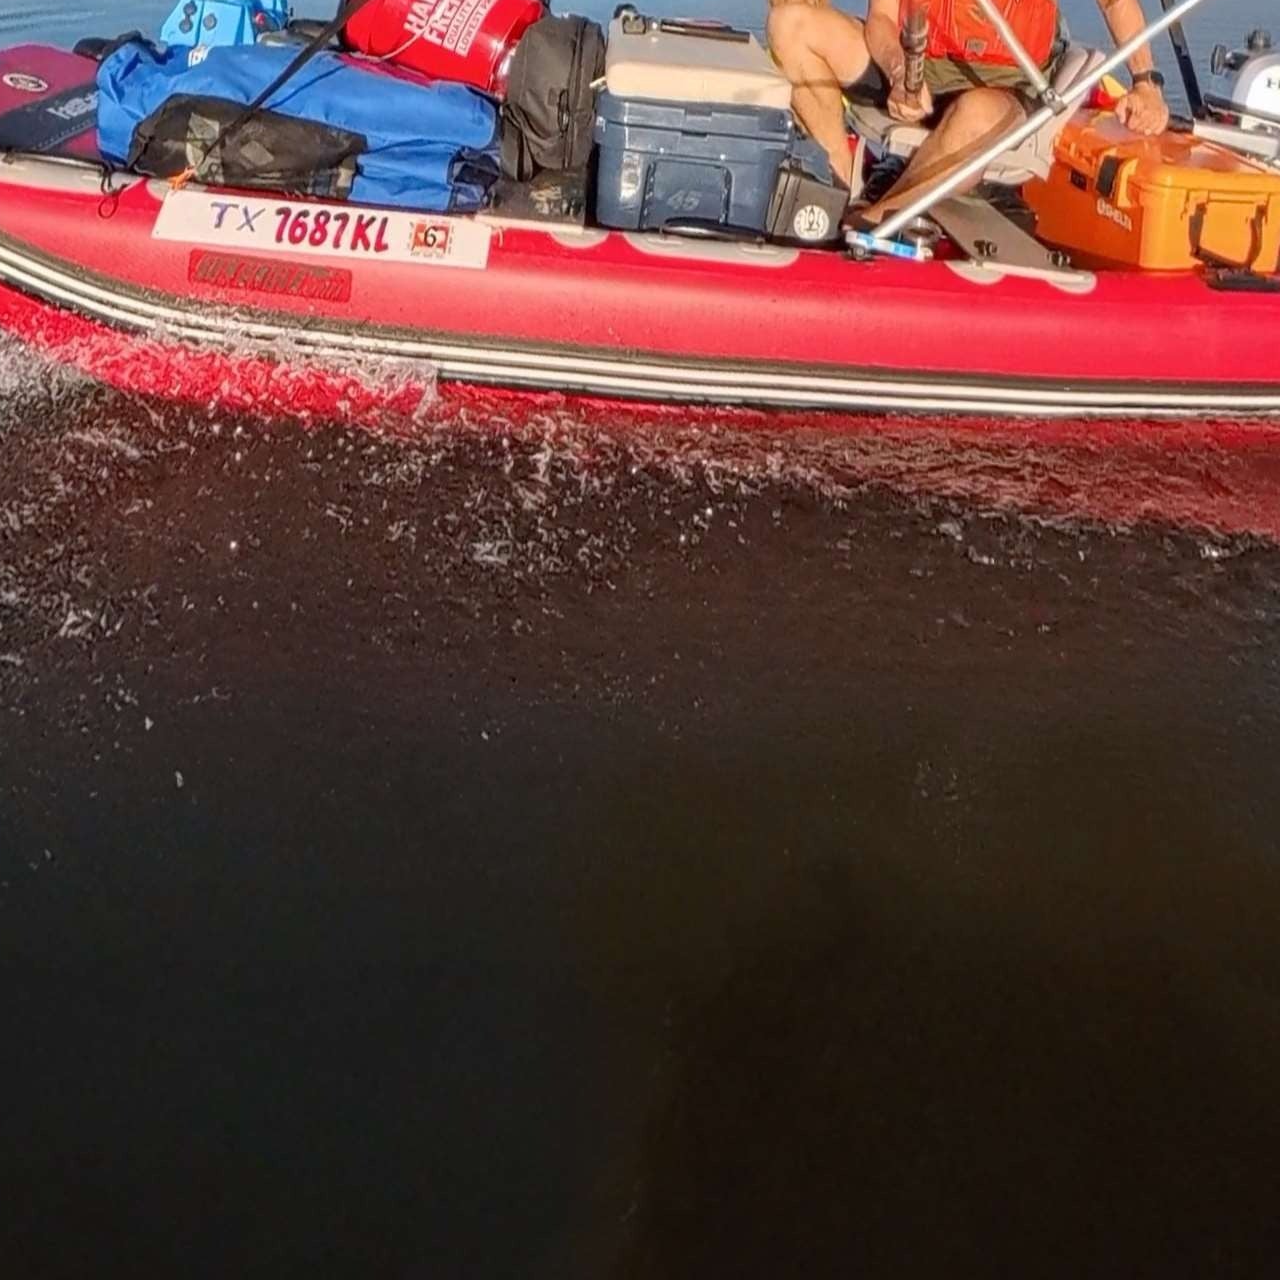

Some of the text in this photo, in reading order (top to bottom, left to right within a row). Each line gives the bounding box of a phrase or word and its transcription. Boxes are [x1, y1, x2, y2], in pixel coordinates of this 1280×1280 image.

[667, 189, 702, 211] 45
[209, 201, 266, 233] TX
[423, 225, 437, 248] 6
